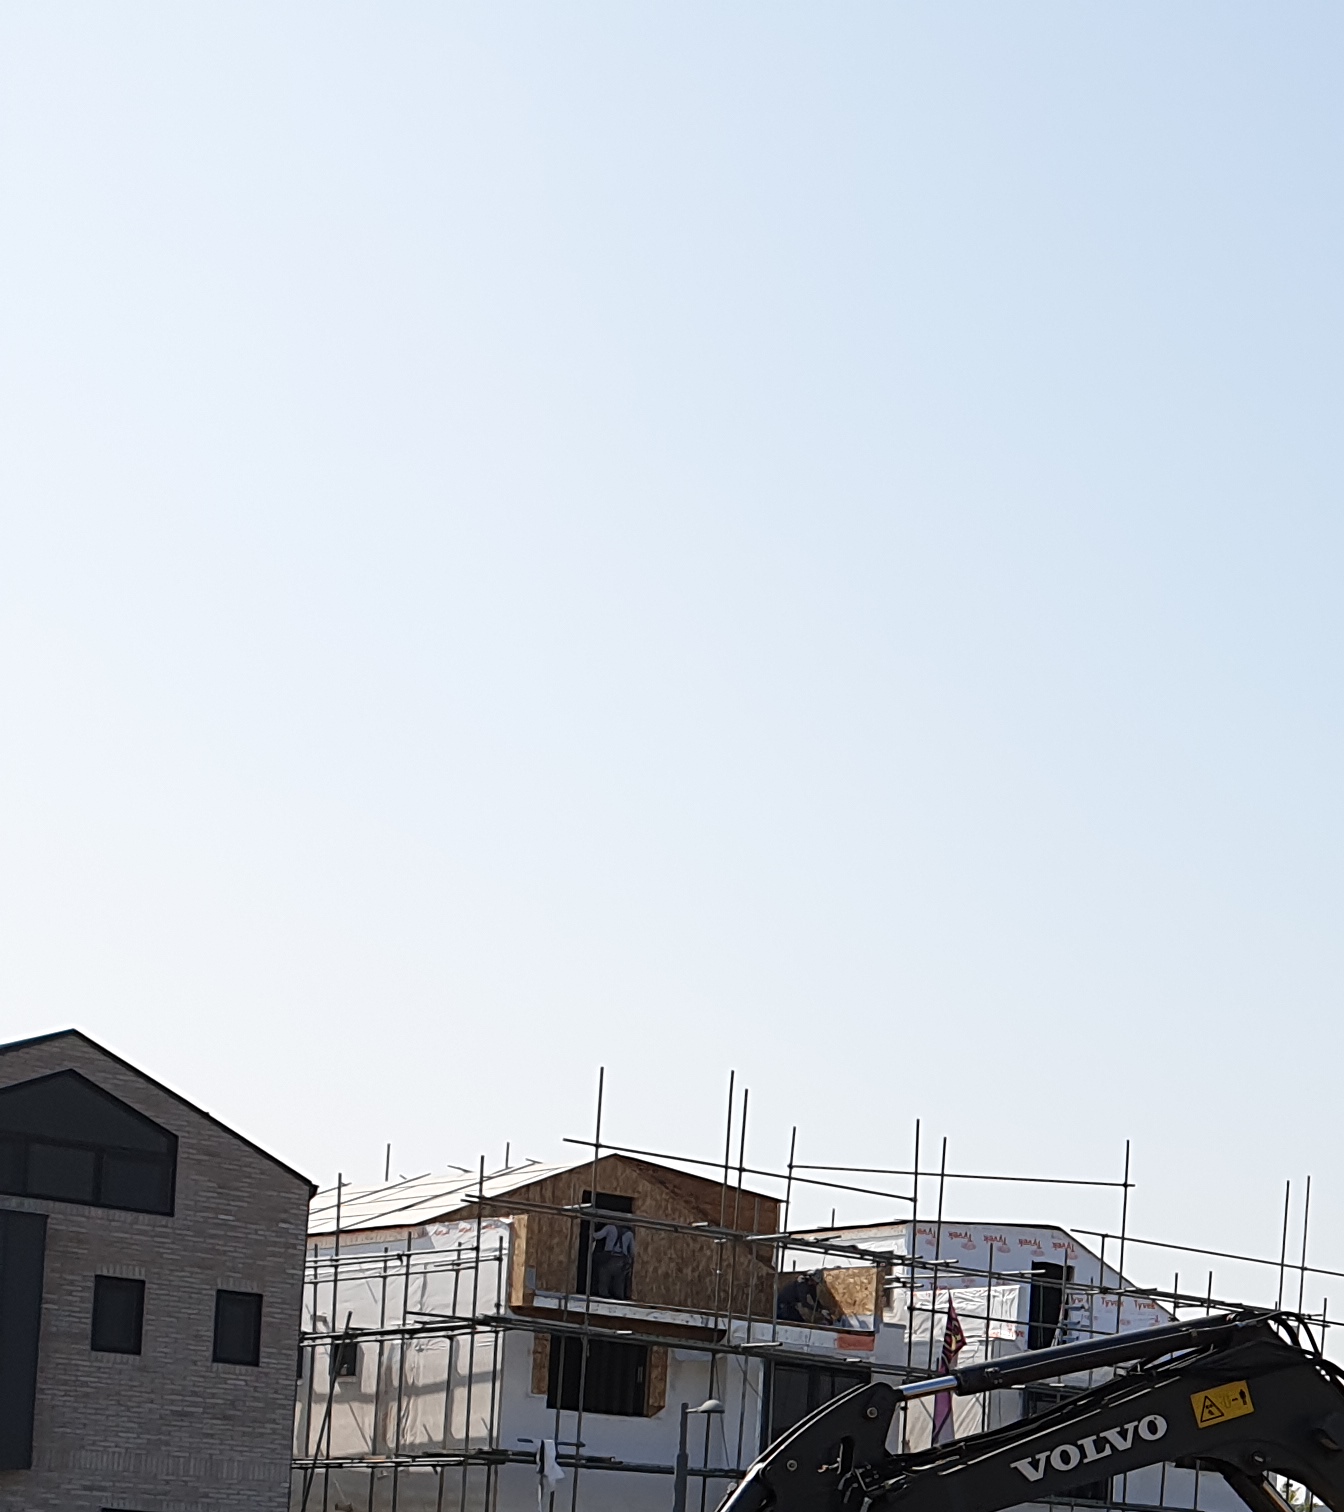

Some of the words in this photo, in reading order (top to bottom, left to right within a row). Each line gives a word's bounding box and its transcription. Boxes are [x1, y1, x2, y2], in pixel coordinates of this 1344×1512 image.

[948, 1231, 972, 1243] Tyvek
[983, 1234, 1007, 1246] Tyvek
[1018, 1238, 1042, 1249] Tyvek
[1010, 1414, 1168, 1482] VOLVO
